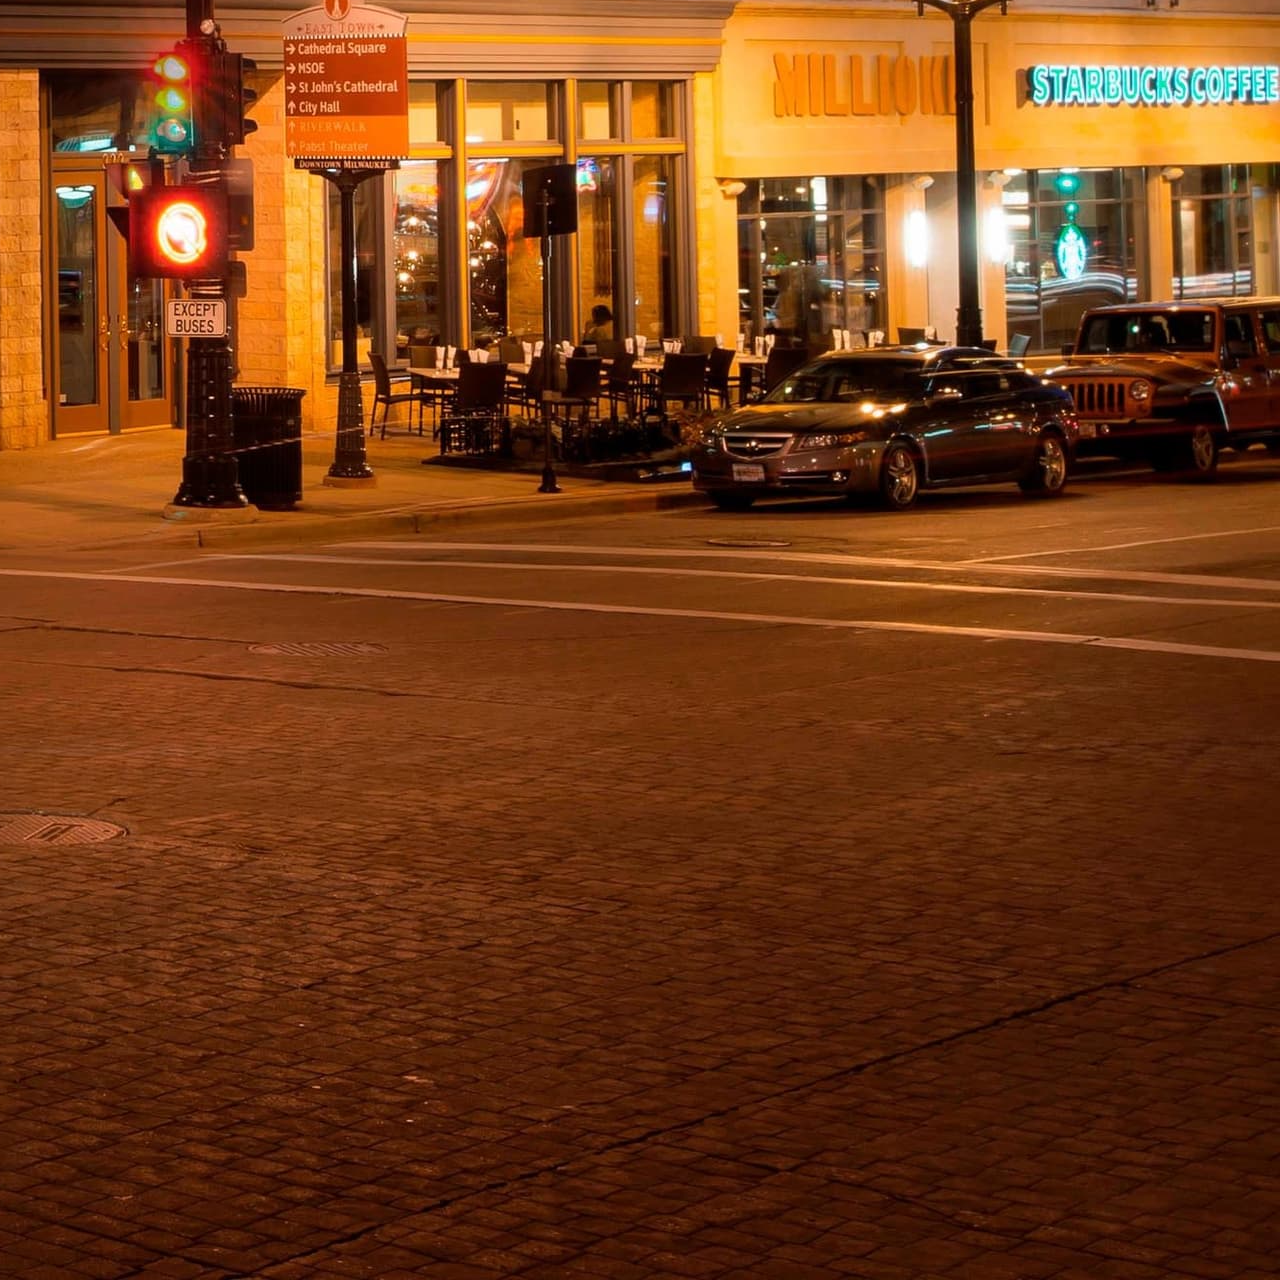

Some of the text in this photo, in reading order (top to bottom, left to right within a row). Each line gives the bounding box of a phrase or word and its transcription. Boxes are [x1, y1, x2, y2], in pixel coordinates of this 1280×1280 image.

[305, 22, 375, 34] EAST TOWN
[298, 41, 387, 56] Cathedral Square
[298, 62, 325, 74] MSOE
[299, 80, 398, 93] St John's Cathedral
[1032, 65, 1280, 104] STARBUCKS COFFEE
[299, 100, 341, 116] City Hall
[300, 122, 367, 133] RIVERWALK
[300, 140, 369, 152] Pabst Theater
[299, 160, 391, 169] DOWNTOWN MILWAUKEE
[174, 303, 218, 317] EXCEPT
[176, 319, 215, 333] BUSES
